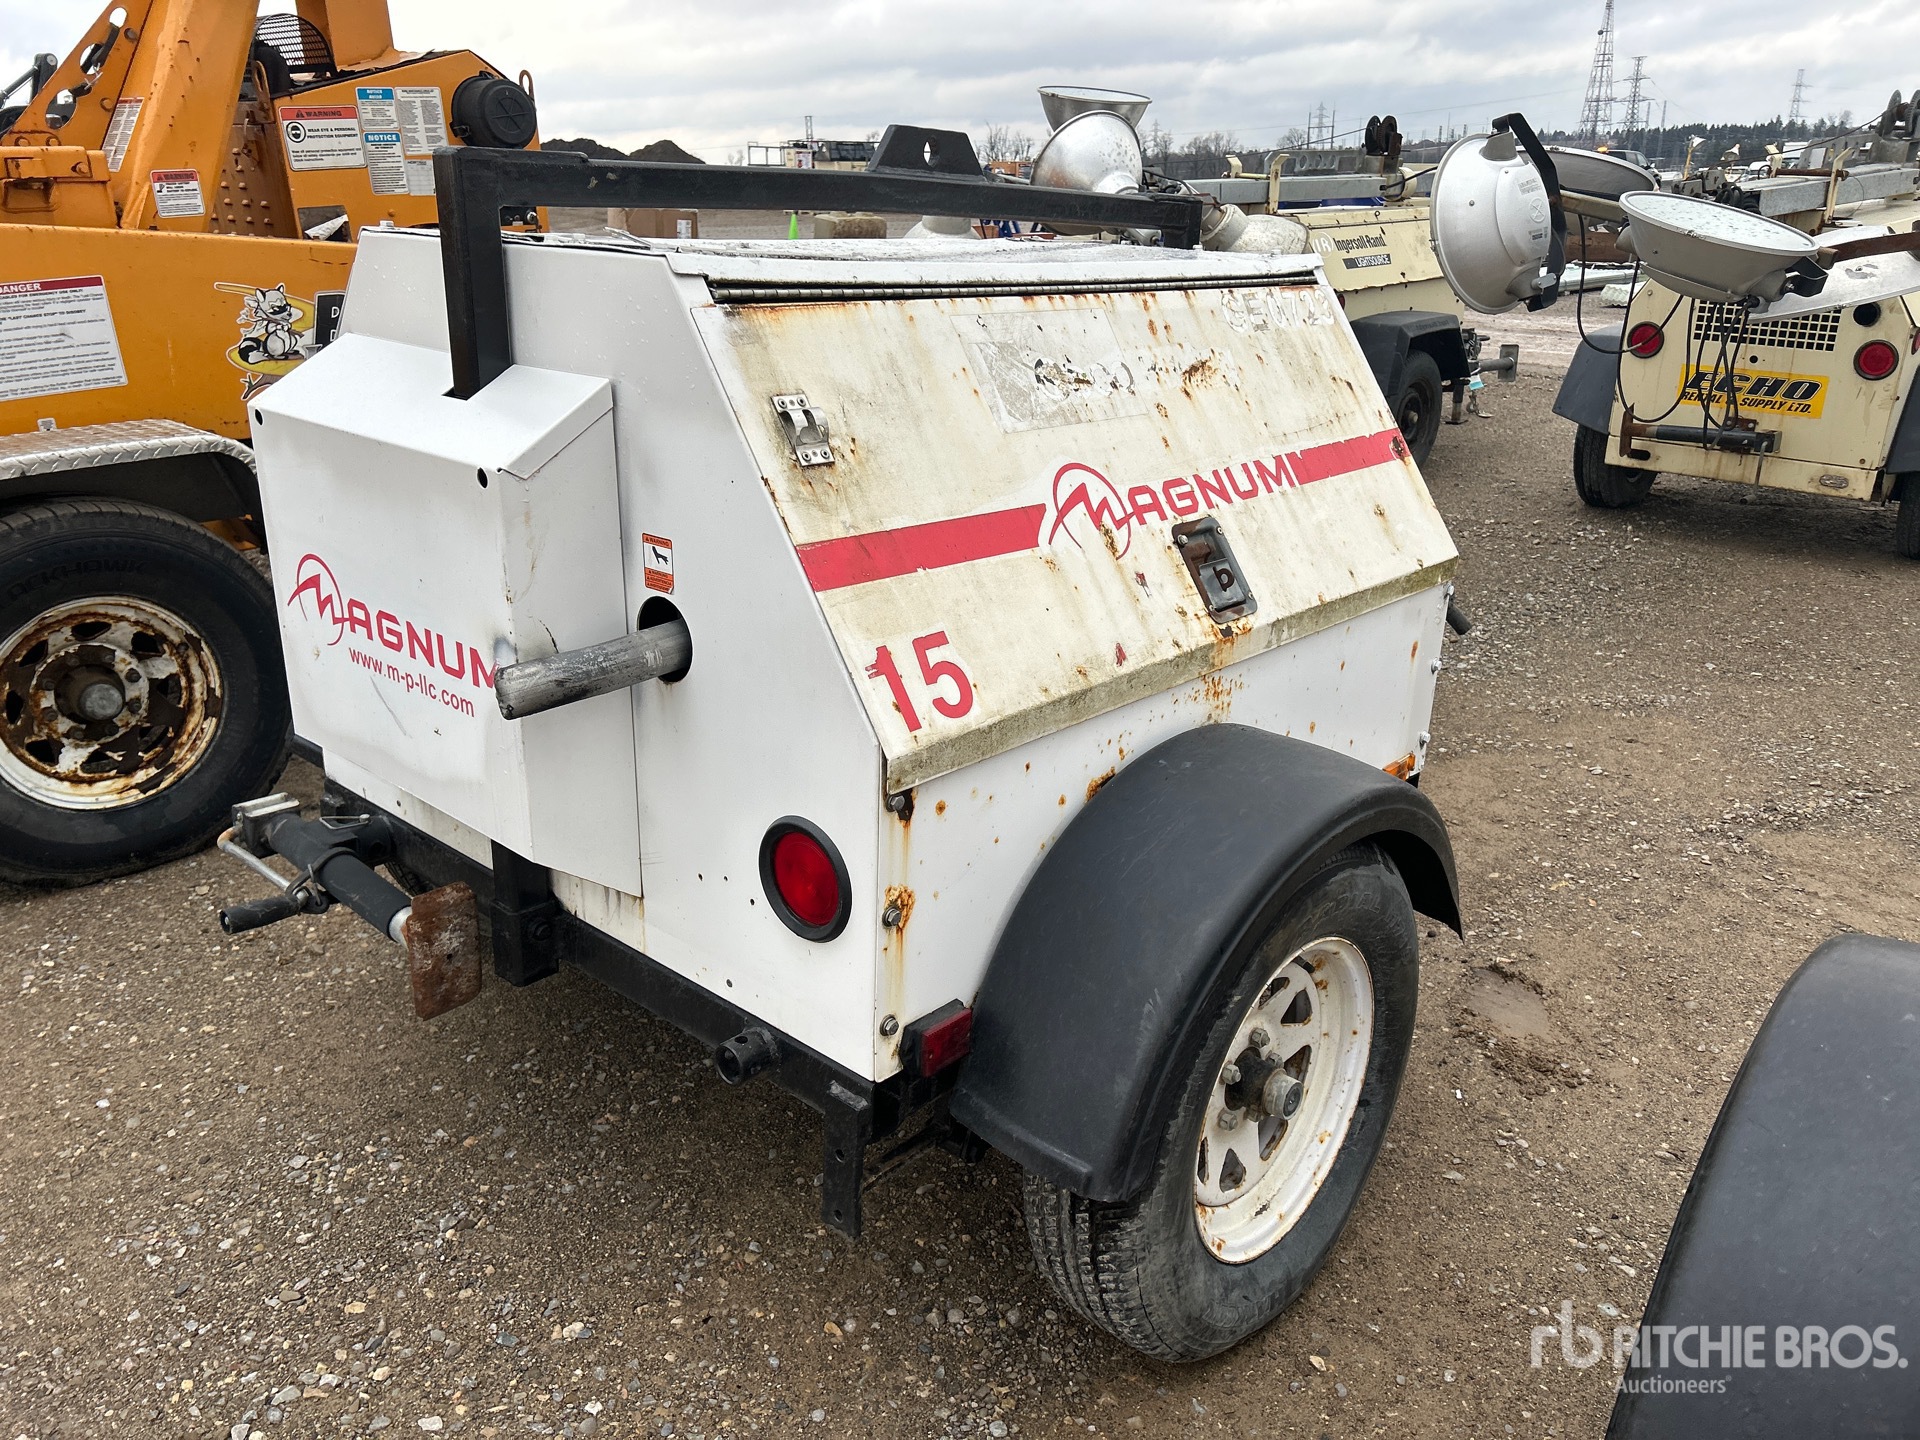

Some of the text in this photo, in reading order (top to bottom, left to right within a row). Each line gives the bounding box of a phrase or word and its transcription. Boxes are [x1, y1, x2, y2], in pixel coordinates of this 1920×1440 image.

[1354, 254, 1390, 268] LIGHTSOURCE
[1685, 371, 1822, 401] ECHO
[1740, 397, 1787, 411] SUPPLY
[650, 536, 670, 546] WARNING
[348, 645, 475, 718] www.m-p-llc.com
[865, 630, 974, 733] 15
